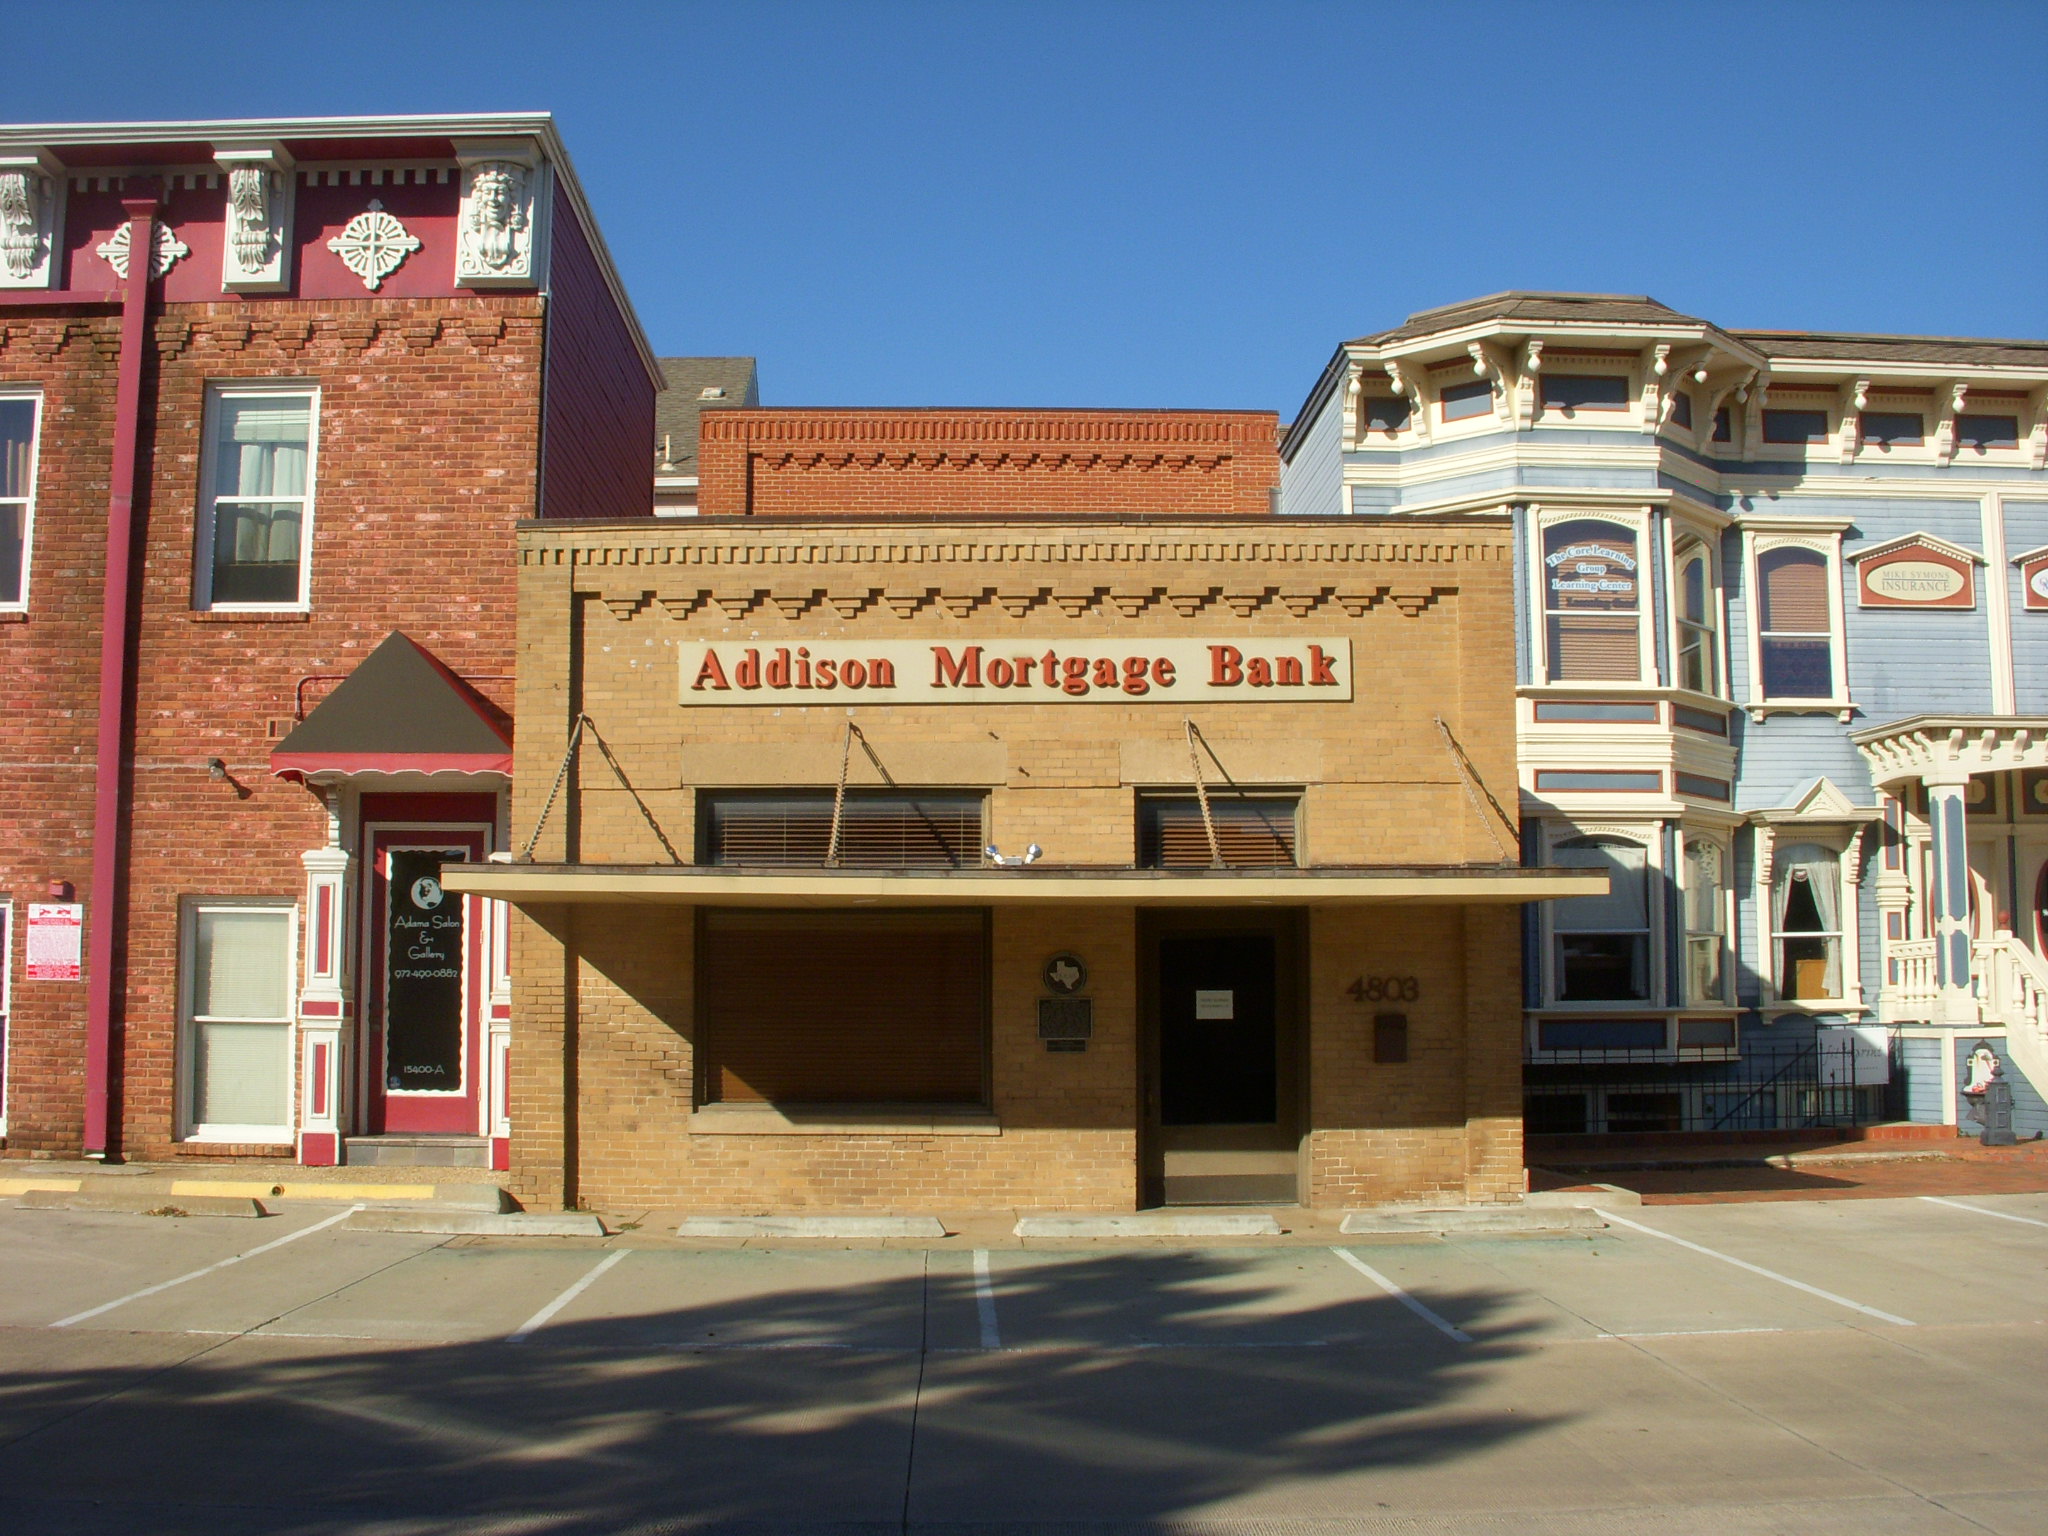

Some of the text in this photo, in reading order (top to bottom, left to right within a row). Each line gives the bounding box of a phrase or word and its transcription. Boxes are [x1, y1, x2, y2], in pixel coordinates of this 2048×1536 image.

[1546, 545, 1635, 569] The Core Learning
[1577, 563, 1606, 574] Group
[1553, 580, 1631, 591] Learning Center
[1882, 580, 1951, 591] INSURANCE
[693, 645, 1339, 694] Addison Mortgage Bank
[394, 915, 460, 929] Adama Salon
[419, 931, 434, 944] &
[408, 946, 445, 961] Gallery
[1346, 976, 1420, 1002] 4803
[403, 1064, 445, 1075] 15400-A
